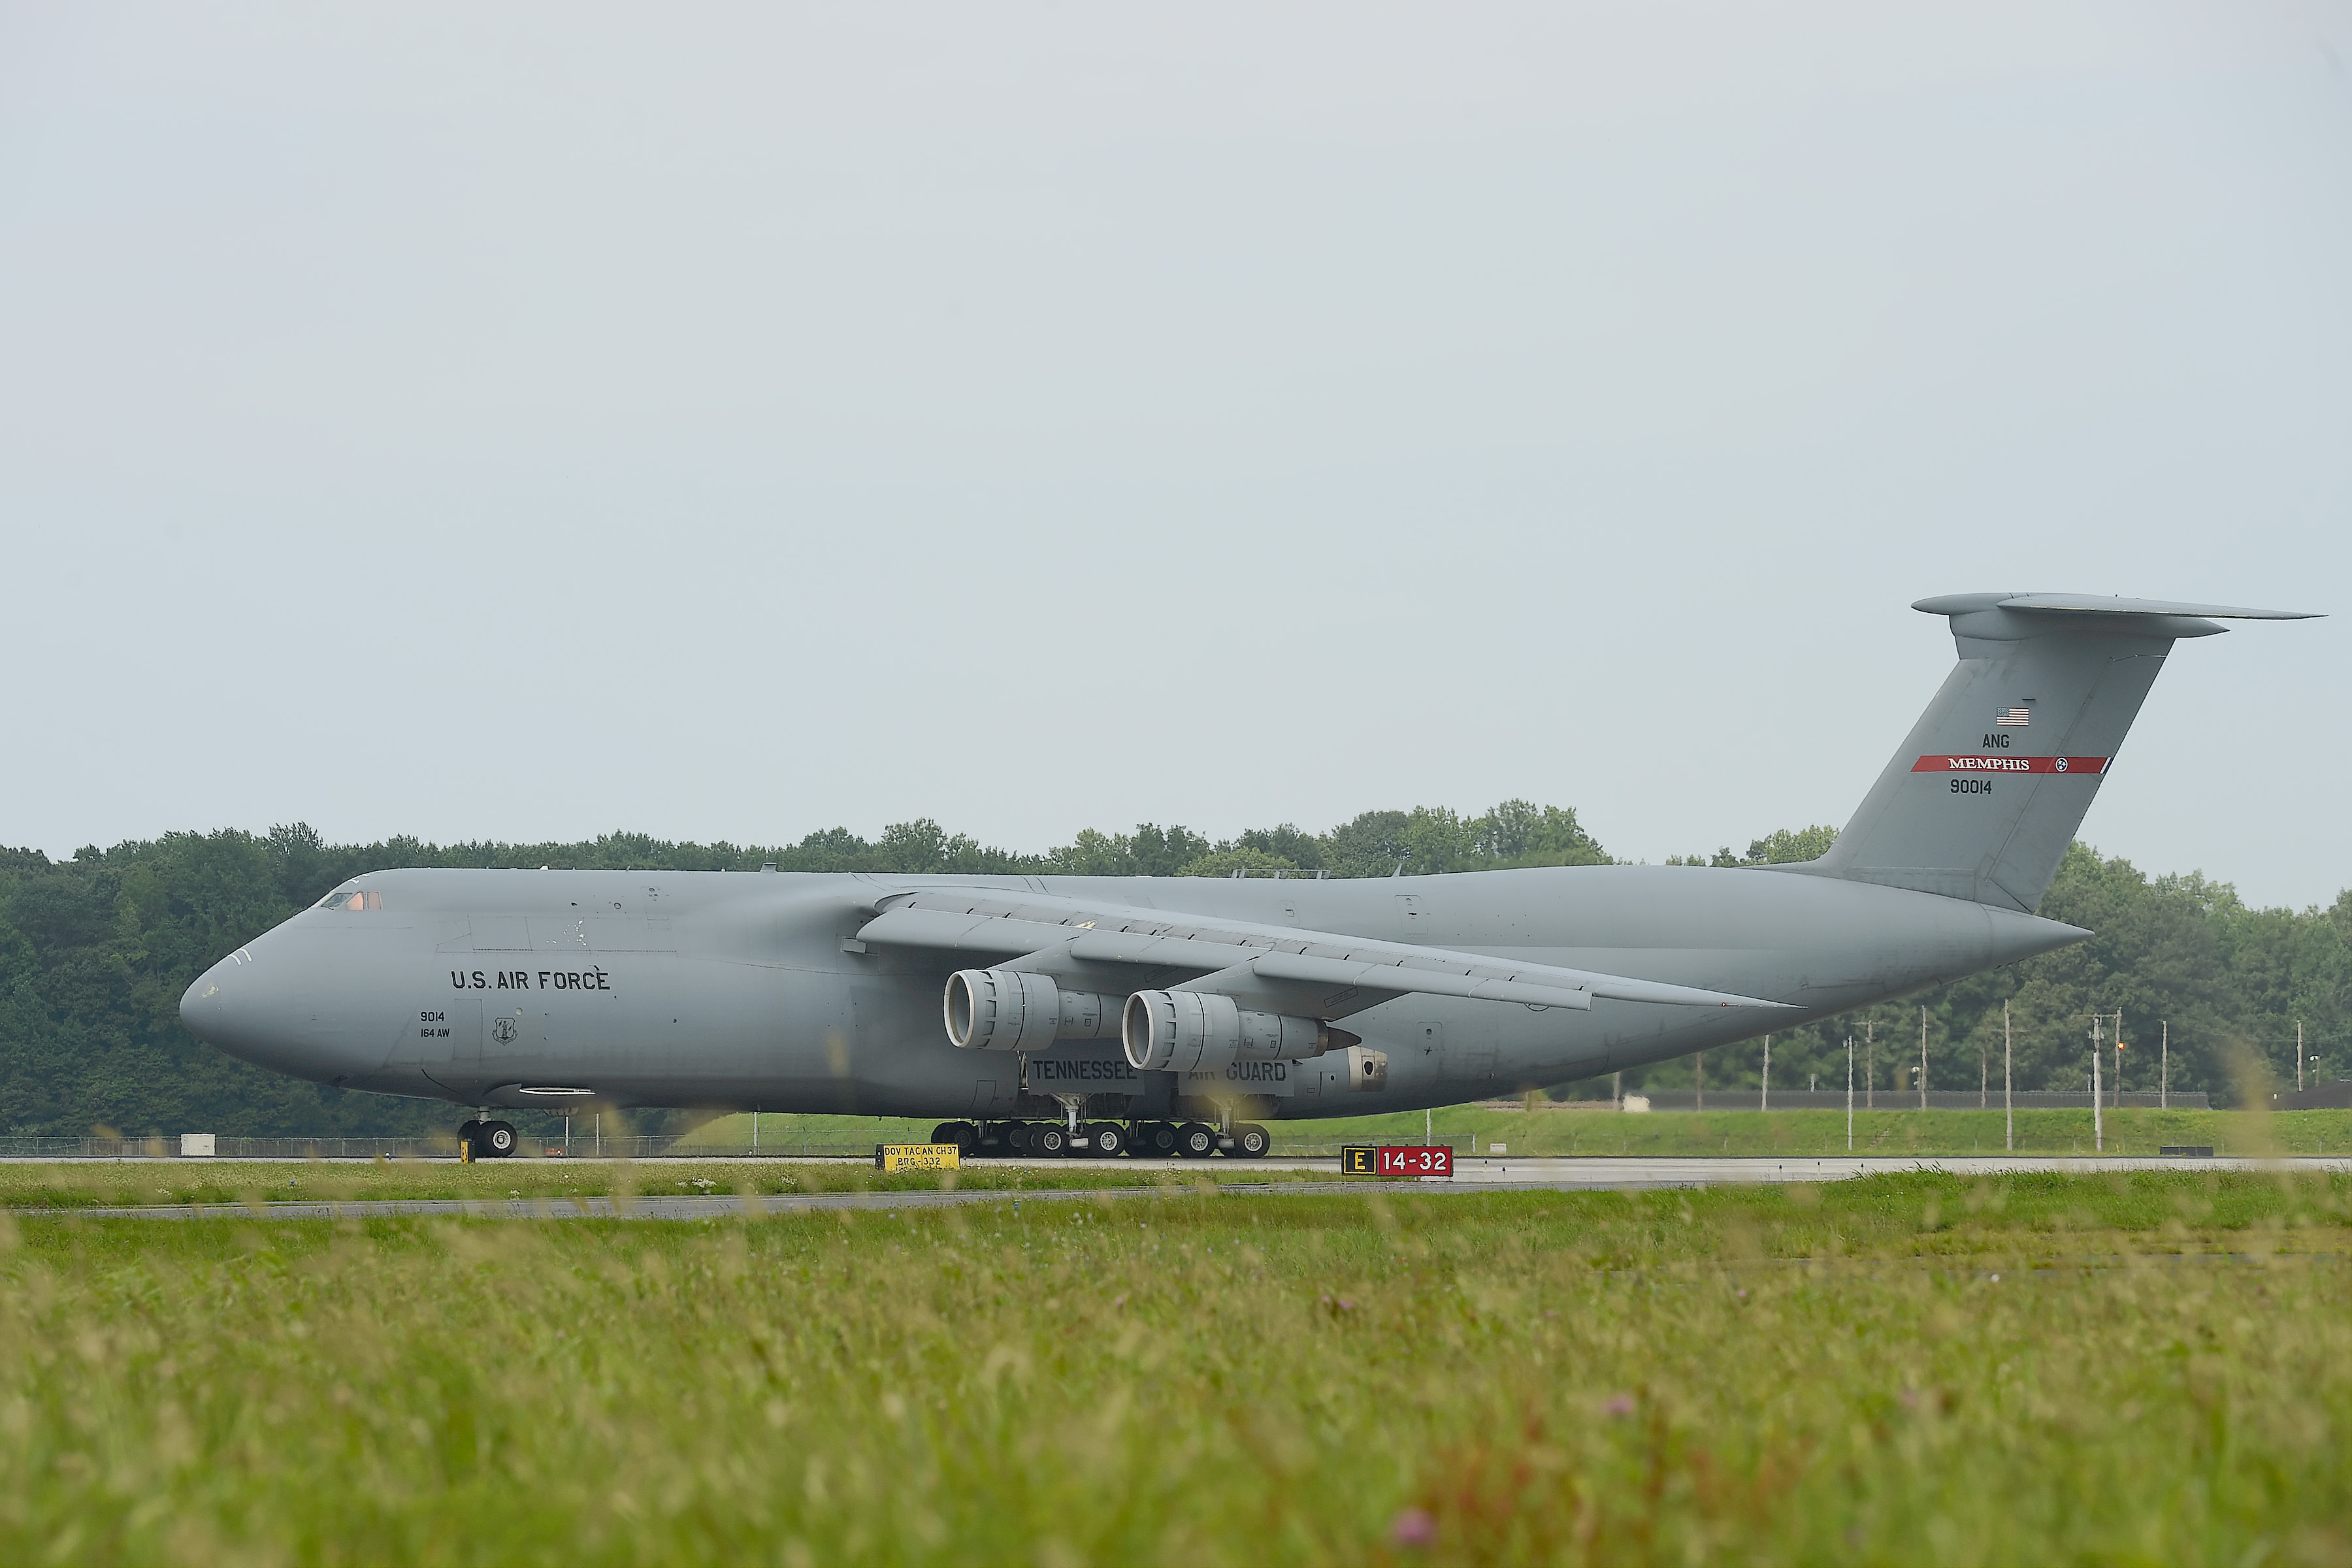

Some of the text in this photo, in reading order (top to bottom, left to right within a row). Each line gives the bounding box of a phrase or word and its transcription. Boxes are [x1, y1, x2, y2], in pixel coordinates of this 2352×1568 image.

[1982, 734, 2010, 748] ANG
[1948, 758, 2030, 770] MEMPHIS
[1950, 779, 1992, 794] 90014
[451, 971, 610, 990] U.S. AIR FORCE
[420, 1011, 445, 1022] 9014
[421, 1028, 449, 1037] 164 AW
[1032, 1060, 1137, 1080] TENNESSEE
[1226, 1062, 1286, 1081] GUARD
[885, 1147, 901, 1156] DOV
[1354, 1152, 1446, 1171] E 14-32
